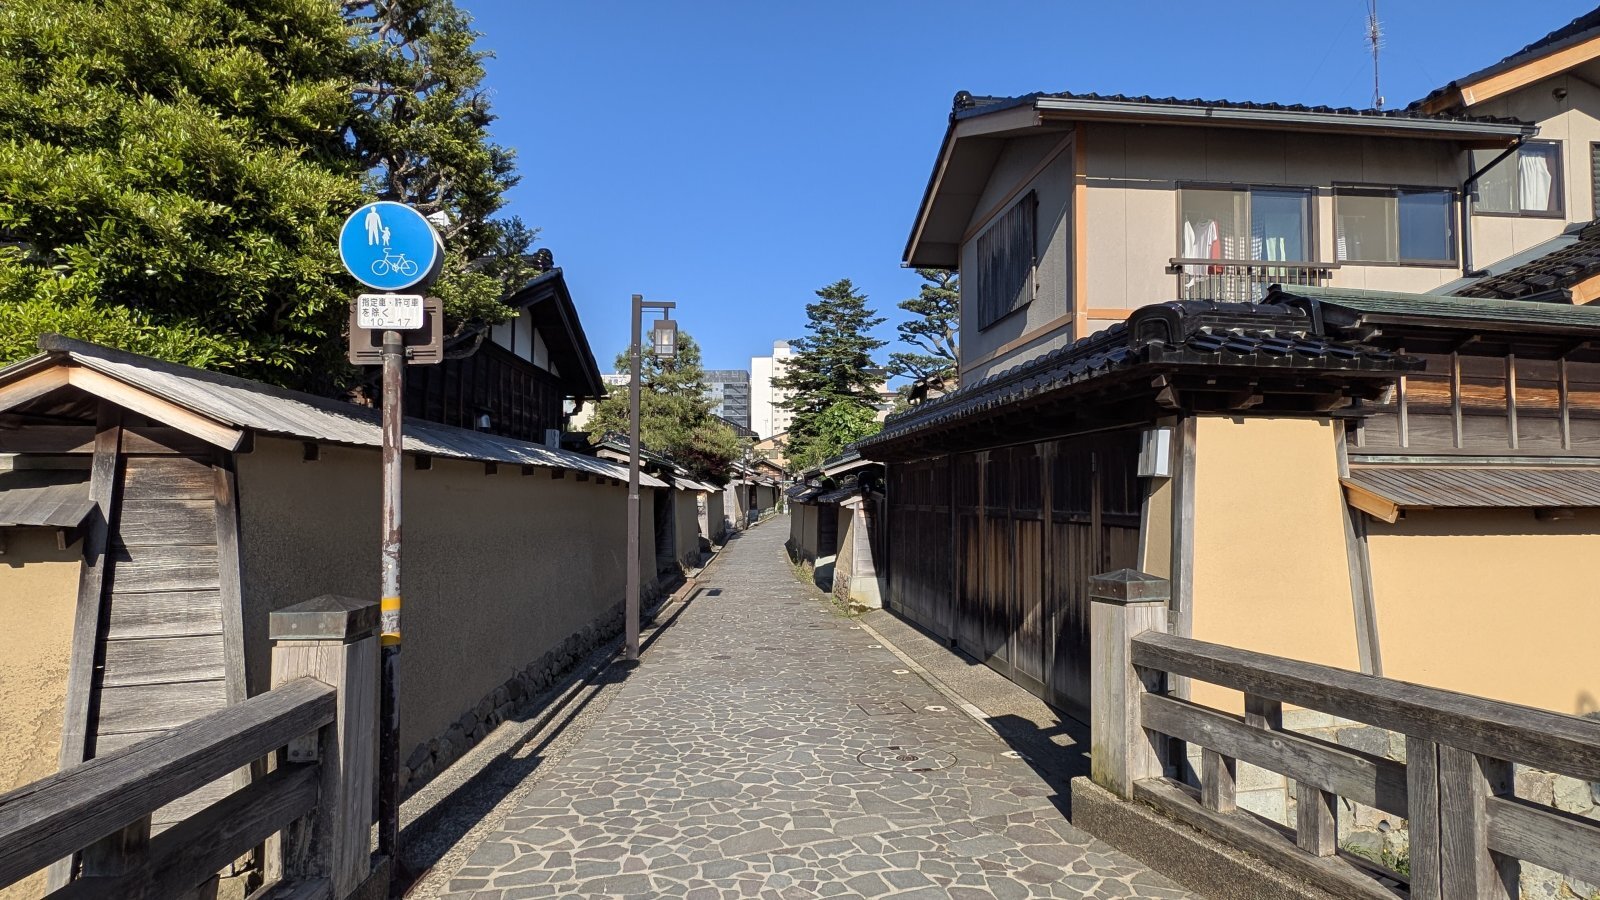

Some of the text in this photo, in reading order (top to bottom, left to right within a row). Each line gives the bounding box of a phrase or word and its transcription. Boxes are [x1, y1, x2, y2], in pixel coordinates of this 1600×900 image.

[362, 298, 418, 307] 指定車・許可車
[362, 308, 389, 317] を除く
